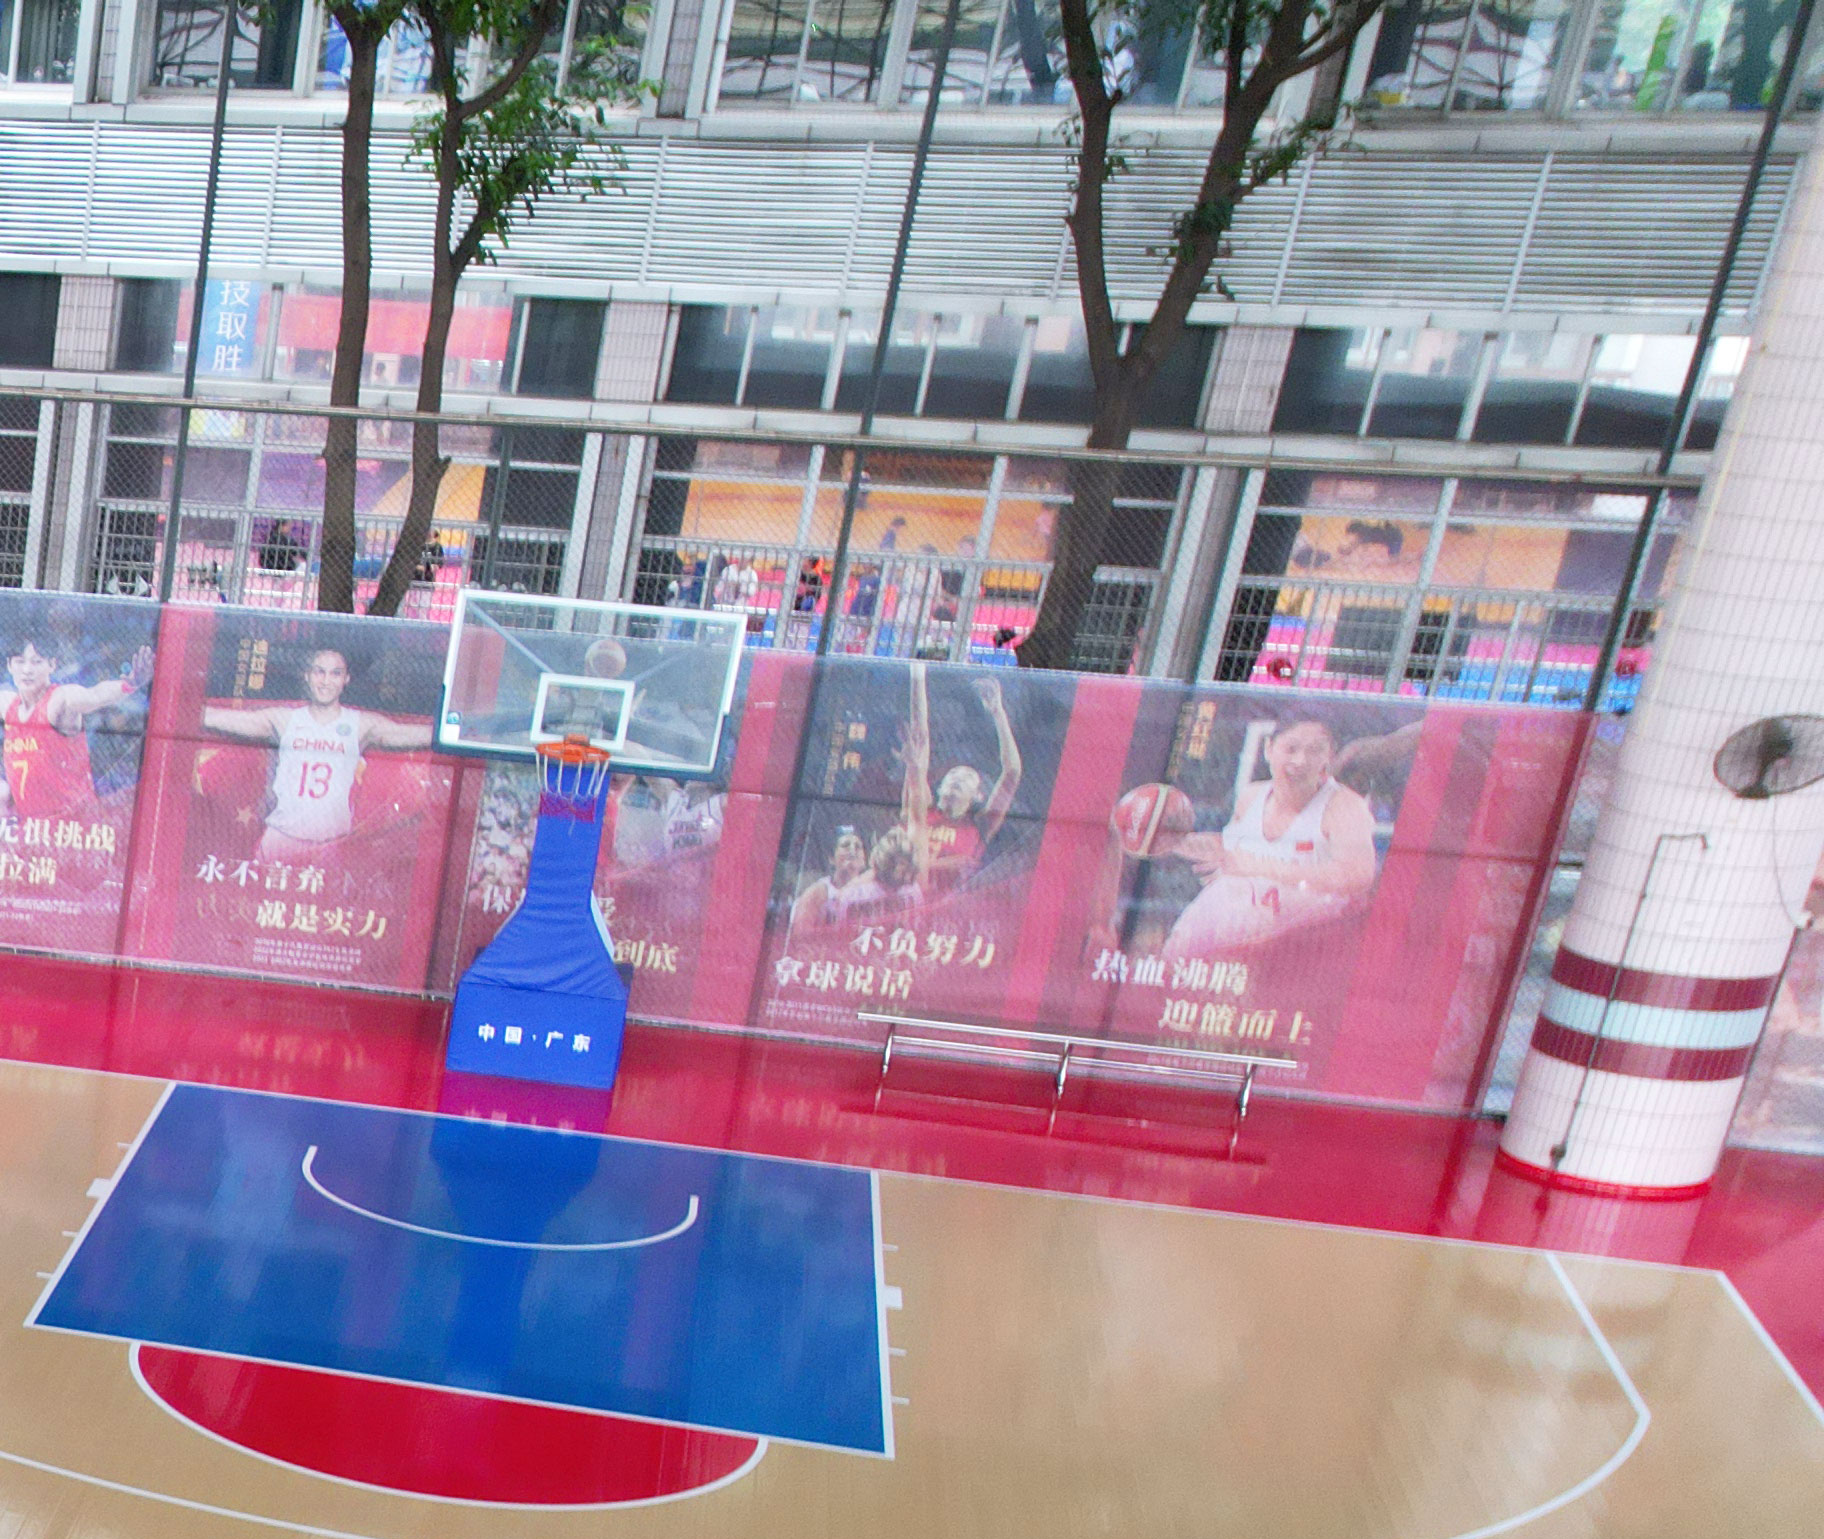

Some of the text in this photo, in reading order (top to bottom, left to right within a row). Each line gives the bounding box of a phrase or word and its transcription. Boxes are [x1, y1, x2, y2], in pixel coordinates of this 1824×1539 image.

[212, 279, 252, 371] 技取胜
[293, 737, 345, 754] CHINA
[12, 759, 29, 800] 7
[298, 762, 333, 799] 13
[196, 854, 326, 895] 永不言弃
[256, 899, 388, 940] 就是实力
[852, 926, 996, 969] 不负努力
[774, 956, 914, 1001] 拿球说话
[1092, 949, 1249, 996] 热血沸腾
[478, 1023, 591, 1053] 中国·广东
[1158, 998, 1312, 1044] 迎篮而上
